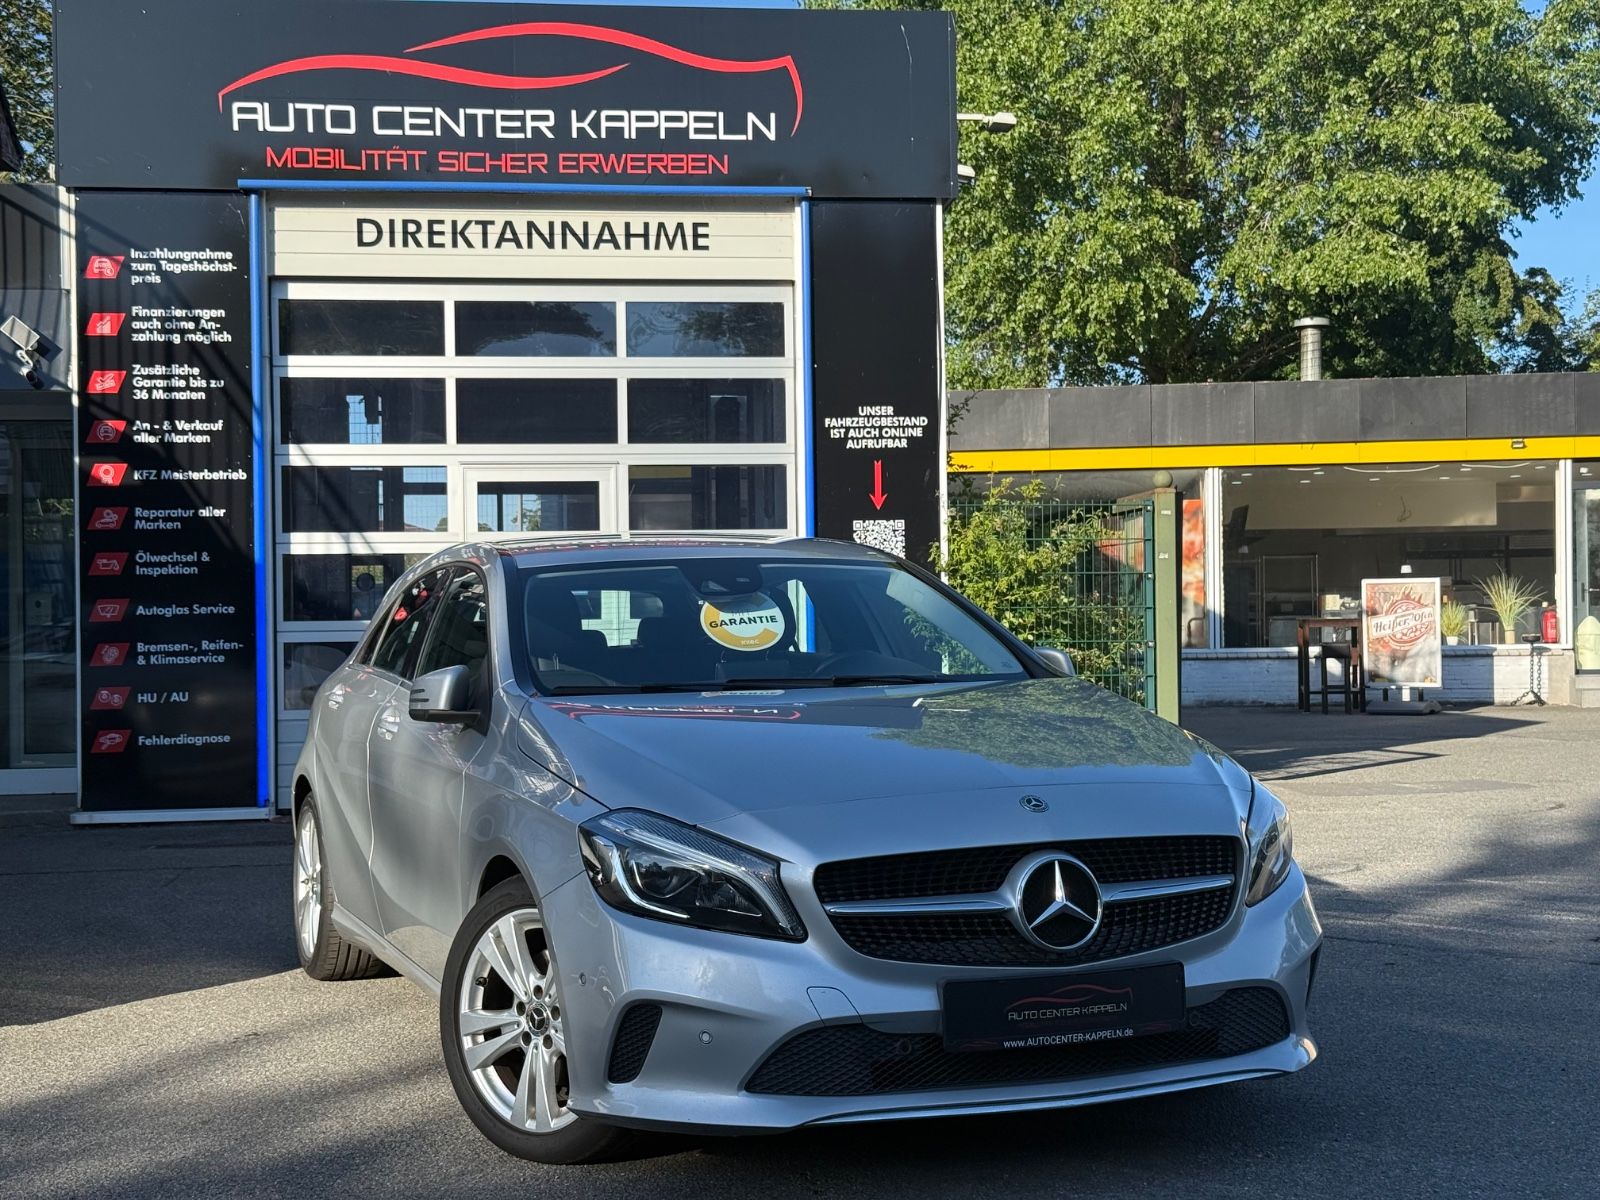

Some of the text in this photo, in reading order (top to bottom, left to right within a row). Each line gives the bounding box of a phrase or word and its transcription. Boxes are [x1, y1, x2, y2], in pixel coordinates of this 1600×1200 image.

[232, 101, 776, 141] AUTO CENTER KAPPELN
[266, 145, 729, 175] MOBILITÄT SICHER ERWERBEN
[356, 217, 710, 251] DIREKTANNAHME
[130, 248, 233, 261] Inzahlungnahme
[130, 260, 237, 273] zum Tageshöchst-
[131, 273, 161, 285] preis
[131, 306, 225, 319] Finanzierungen
[131, 319, 221, 329] auch ohne An-
[131, 331, 232, 344] zahlung möglich
[132, 364, 200, 375] Zusätzliche
[132, 377, 224, 388] Garantie bis zu
[132, 389, 206, 400] 36 Monaten
[858, 406, 894, 416] UNSER
[132, 420, 150, 431] An
[163, 420, 172, 431] &
[175, 419, 224, 431] Verkauf
[825, 417, 928, 428] FAHRZEUGBESTAND
[133, 432, 211, 443] aller Marken
[830, 427, 923, 438] IST AUCH ONLINE
[846, 438, 908, 449] AUFRUFBAR
[133, 469, 247, 481] KFZ Meisterbetrieb
[134, 506, 226, 519] Reparatur aller
[134, 519, 181, 530] Marken
[135, 550, 210, 563] Ölwechsel &
[135, 564, 198, 577] Inspektion
[136, 604, 236, 617] Autoglas Service
[709, 615, 778, 629] GARANTIE
[137, 640, 244, 653] Bremsen-, Reifen-
[137, 653, 225, 665] & Klimaservice
[137, 691, 189, 703] HU / AU
[138, 734, 231, 746] Fehlerdiagnose
[1008, 1002, 1128, 1021] AUTO CENTER KAPPELN
[1003, 1027, 1134, 1048] www.AUTOCENTER-KAPPELN.de
